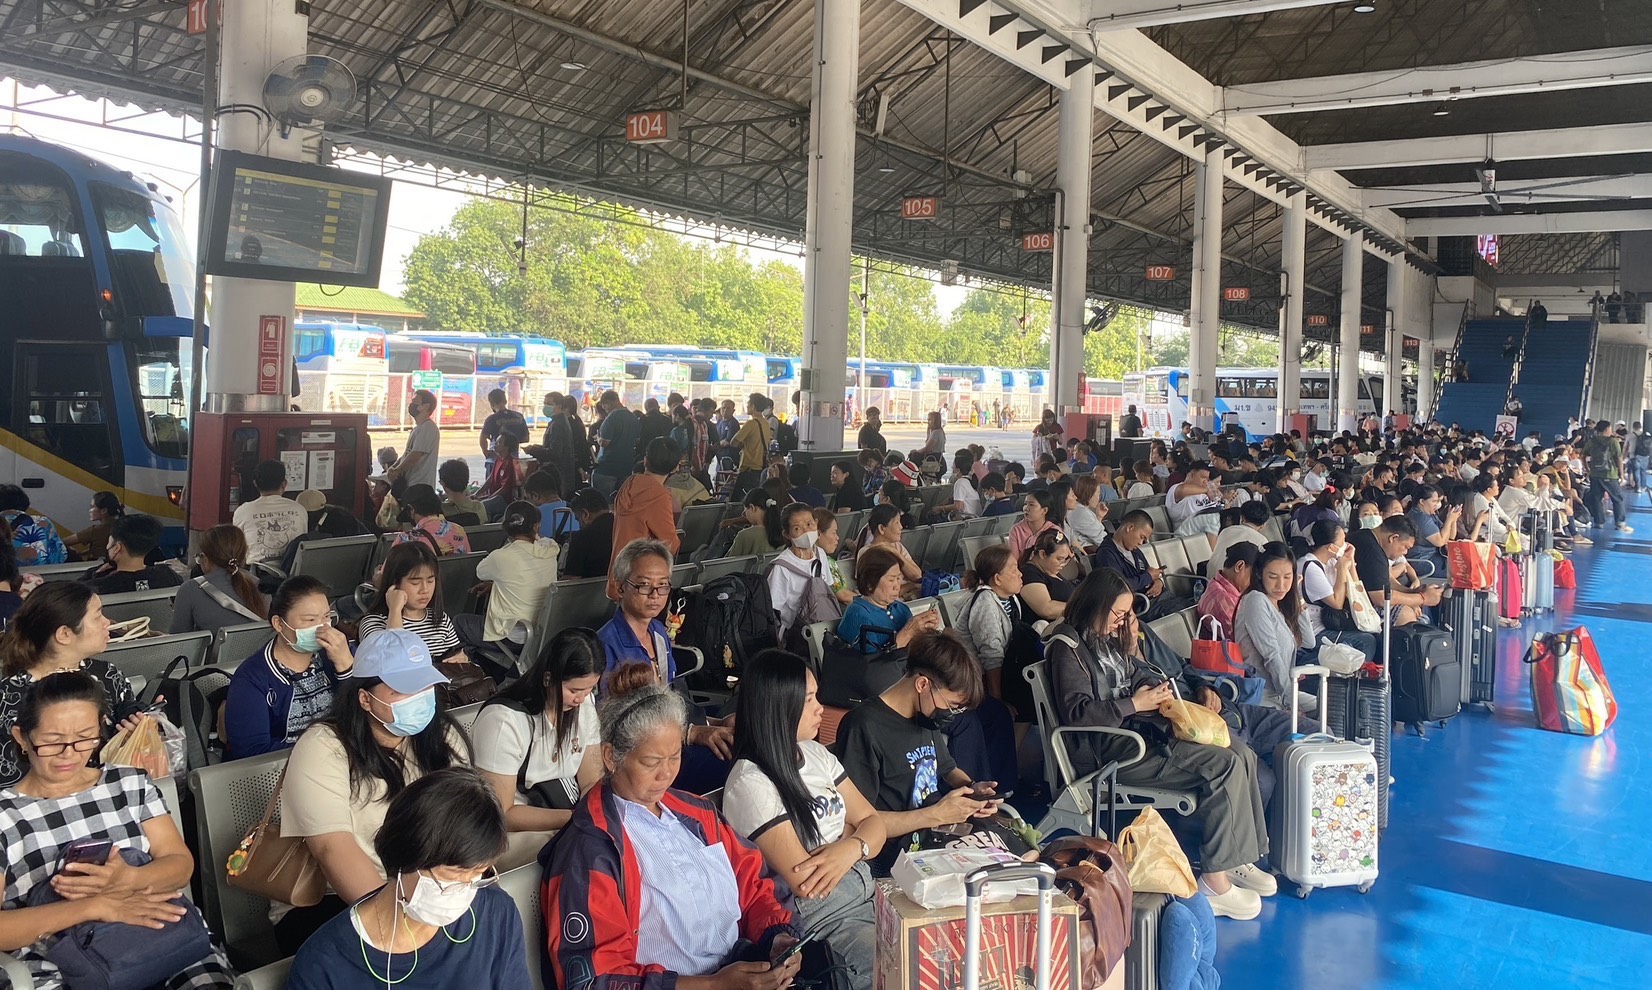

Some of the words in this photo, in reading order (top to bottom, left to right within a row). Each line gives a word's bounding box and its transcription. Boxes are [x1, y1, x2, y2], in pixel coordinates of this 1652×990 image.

[629, 114, 663, 138] 104
[904, 199, 932, 215] 105
[1025, 234, 1050, 249] 106
[1148, 266, 1171, 279] 107
[1227, 289, 1246, 299] 108
[1309, 316, 1325, 325] 110
